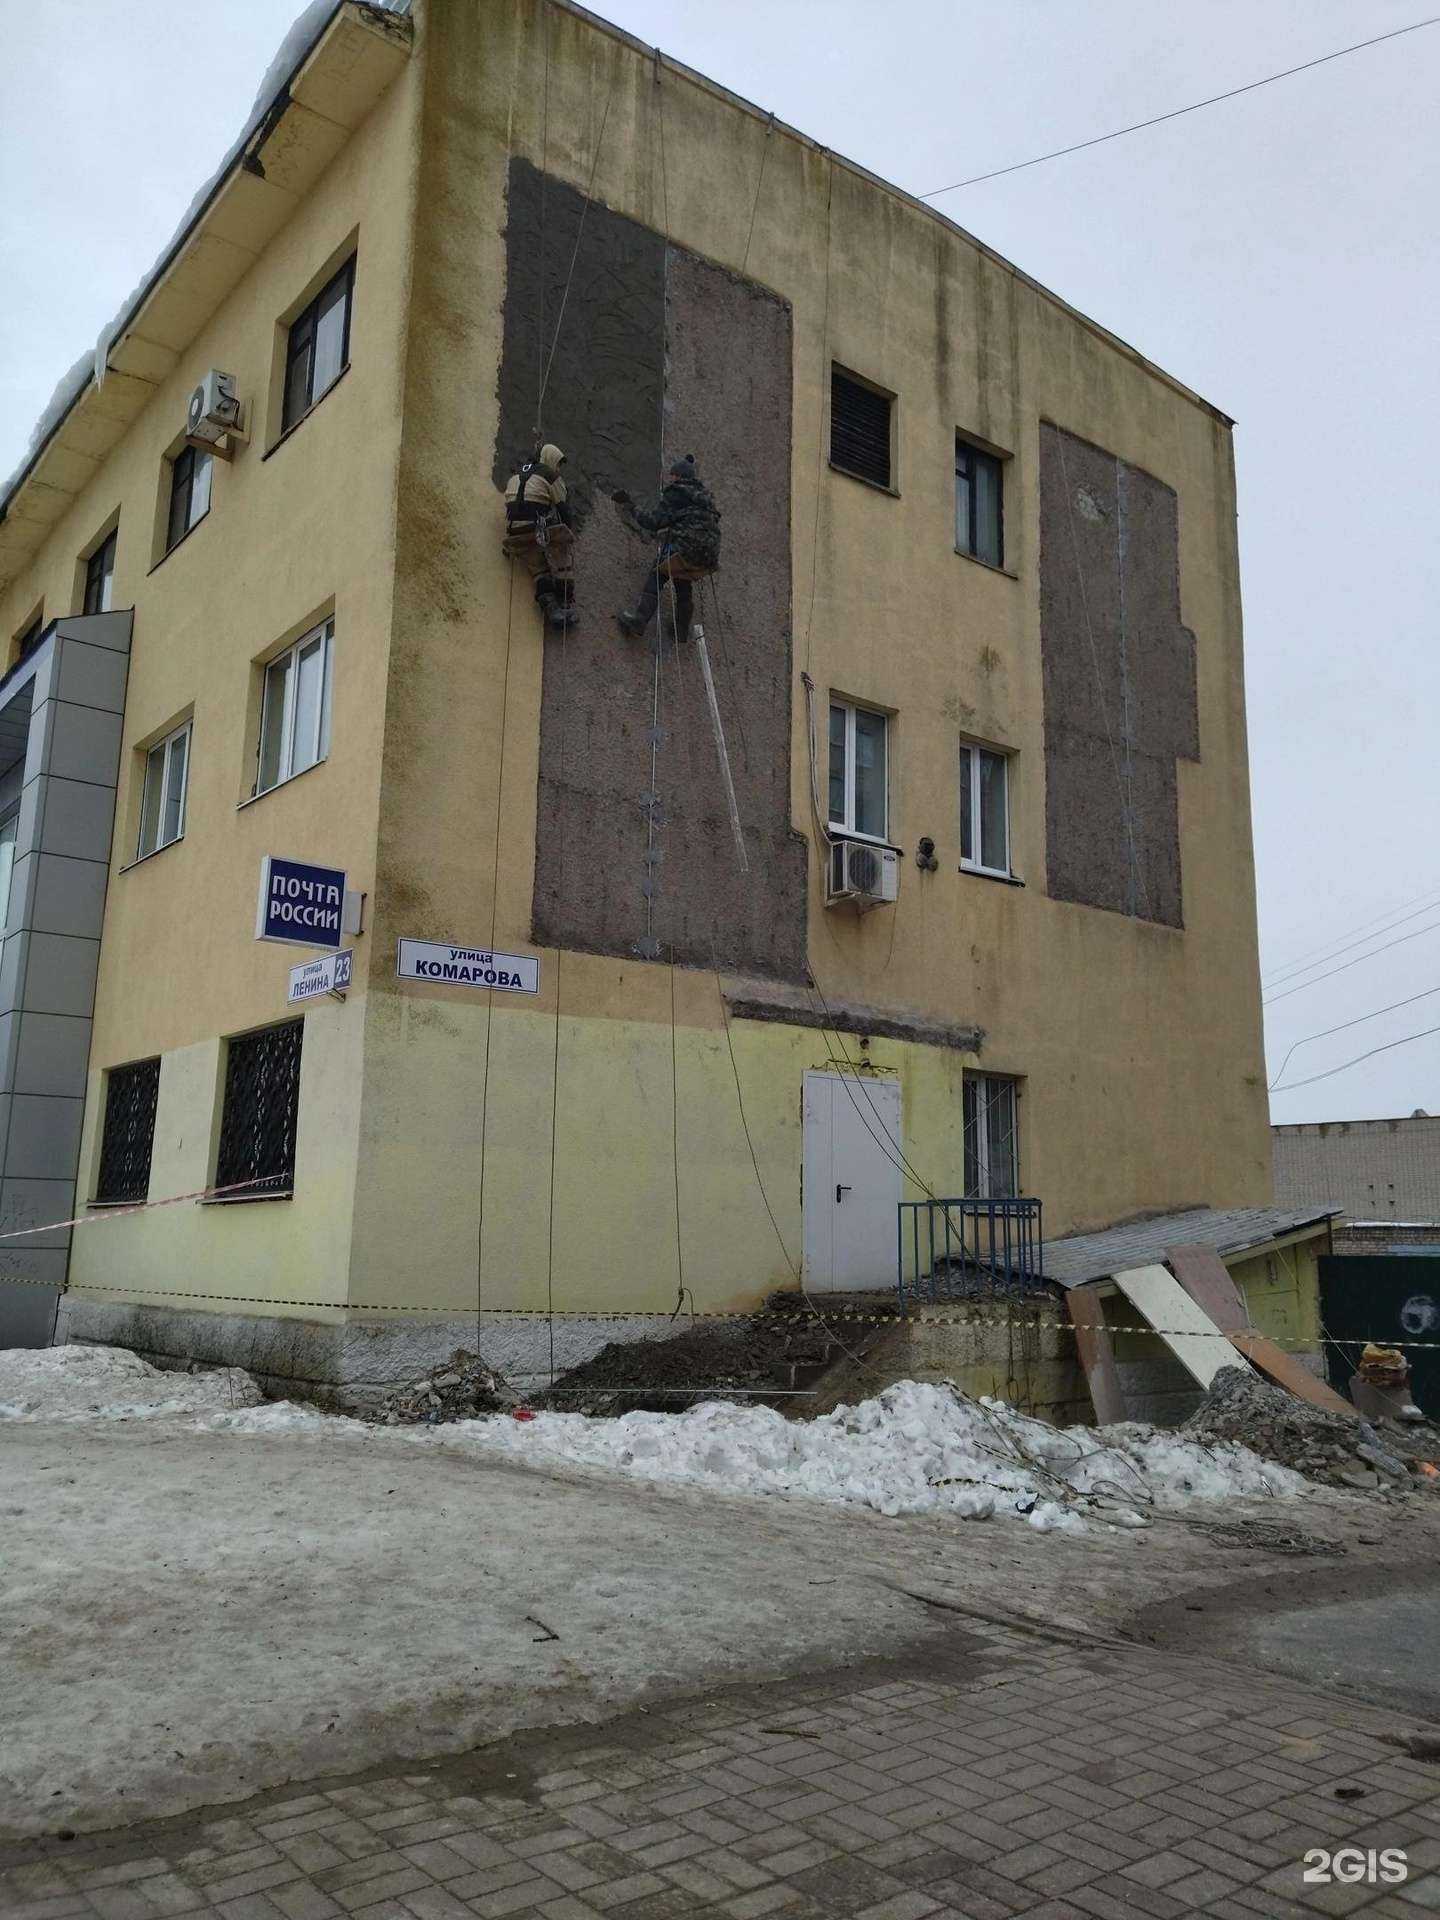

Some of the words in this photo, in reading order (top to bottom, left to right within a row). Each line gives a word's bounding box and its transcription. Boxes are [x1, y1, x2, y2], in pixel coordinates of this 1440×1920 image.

[272, 875, 340, 905] ПОЧТА
[270, 900, 338, 930] РОССИИ
[334, 956, 351, 983] 23
[449, 949, 493, 964] улица
[292, 974, 329, 997] ЛЕНИНА
[415, 959, 522, 987] КОМАРОВА
